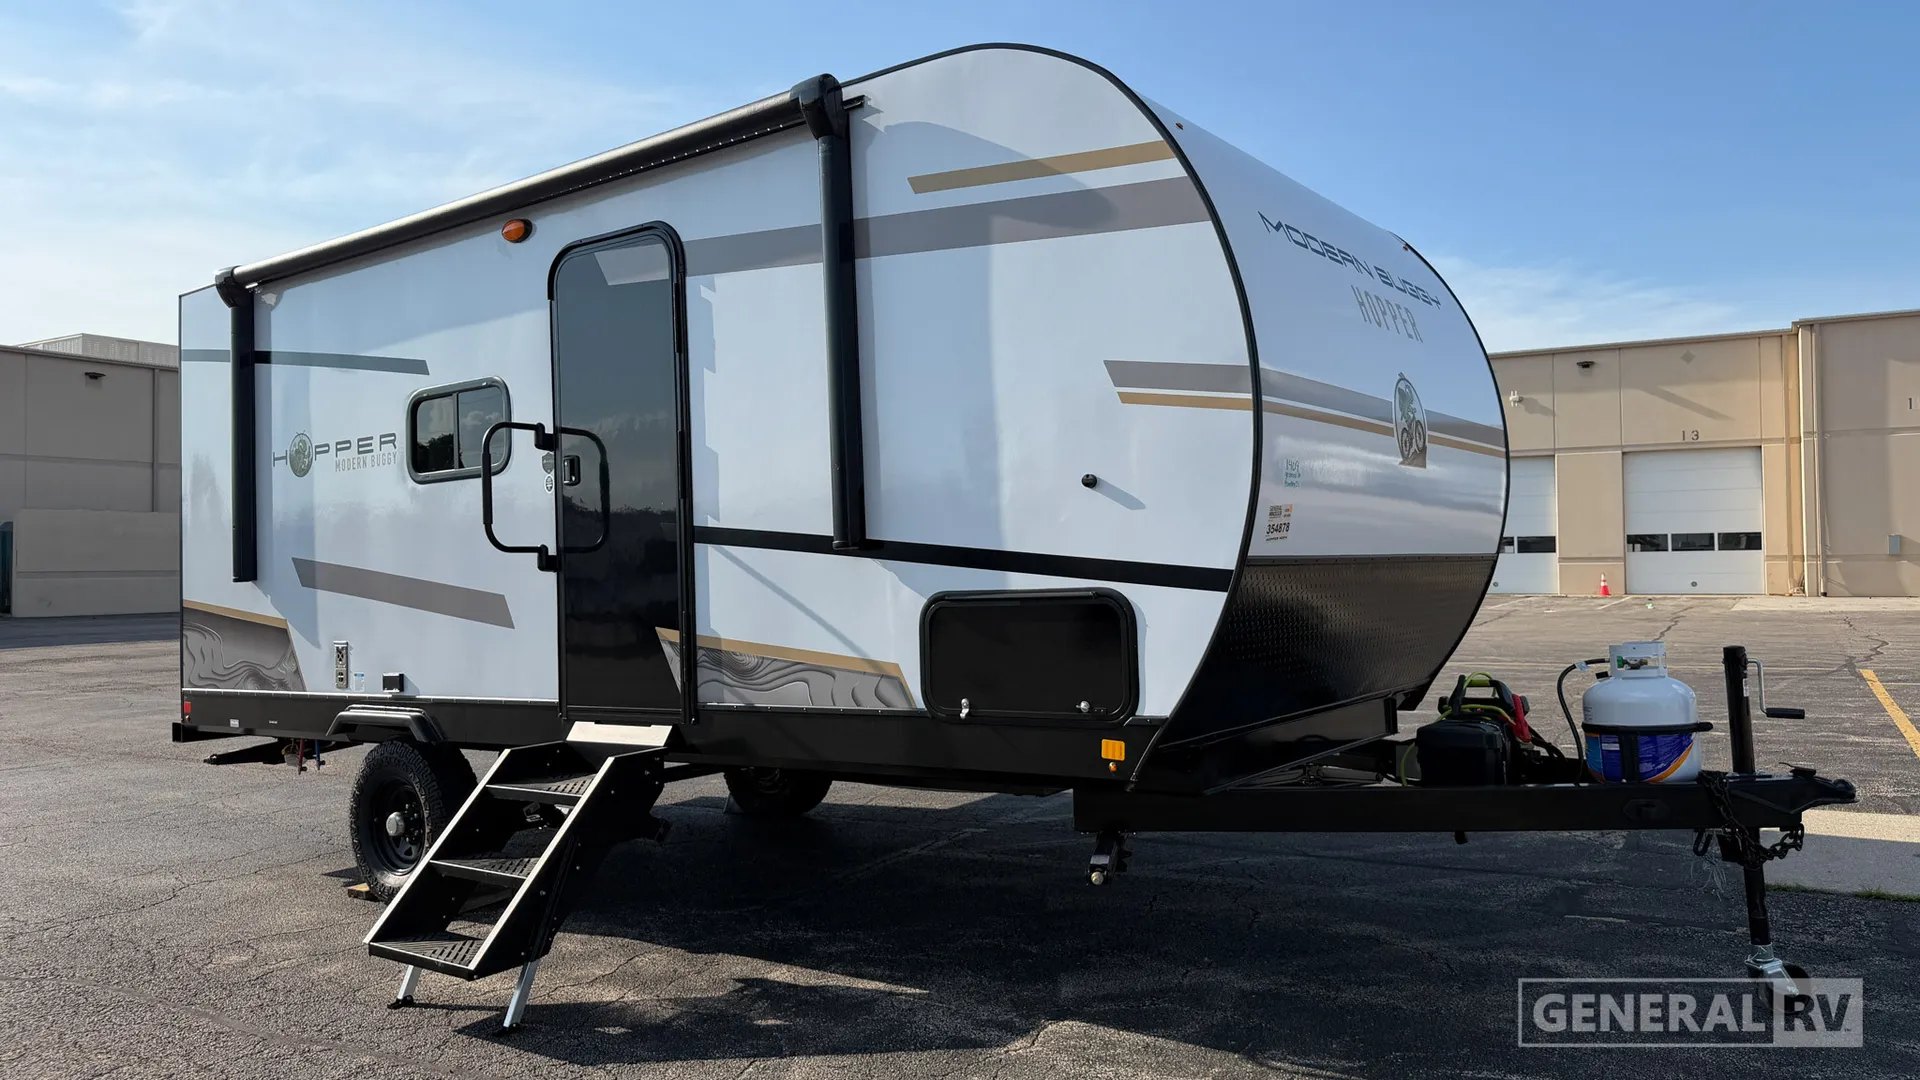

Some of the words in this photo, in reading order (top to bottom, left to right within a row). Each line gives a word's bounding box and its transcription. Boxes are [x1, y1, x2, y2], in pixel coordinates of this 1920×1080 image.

[1257, 211, 1374, 280] MODERN
[1374, 265, 1441, 310] BUGGY
[1351, 285, 1423, 344] HOPPER
[272, 431, 397, 478] HOPPER
[1681, 430, 1700, 442] 13
[335, 457, 367, 473] MODERN
[371, 452, 398, 468] BUGGY
